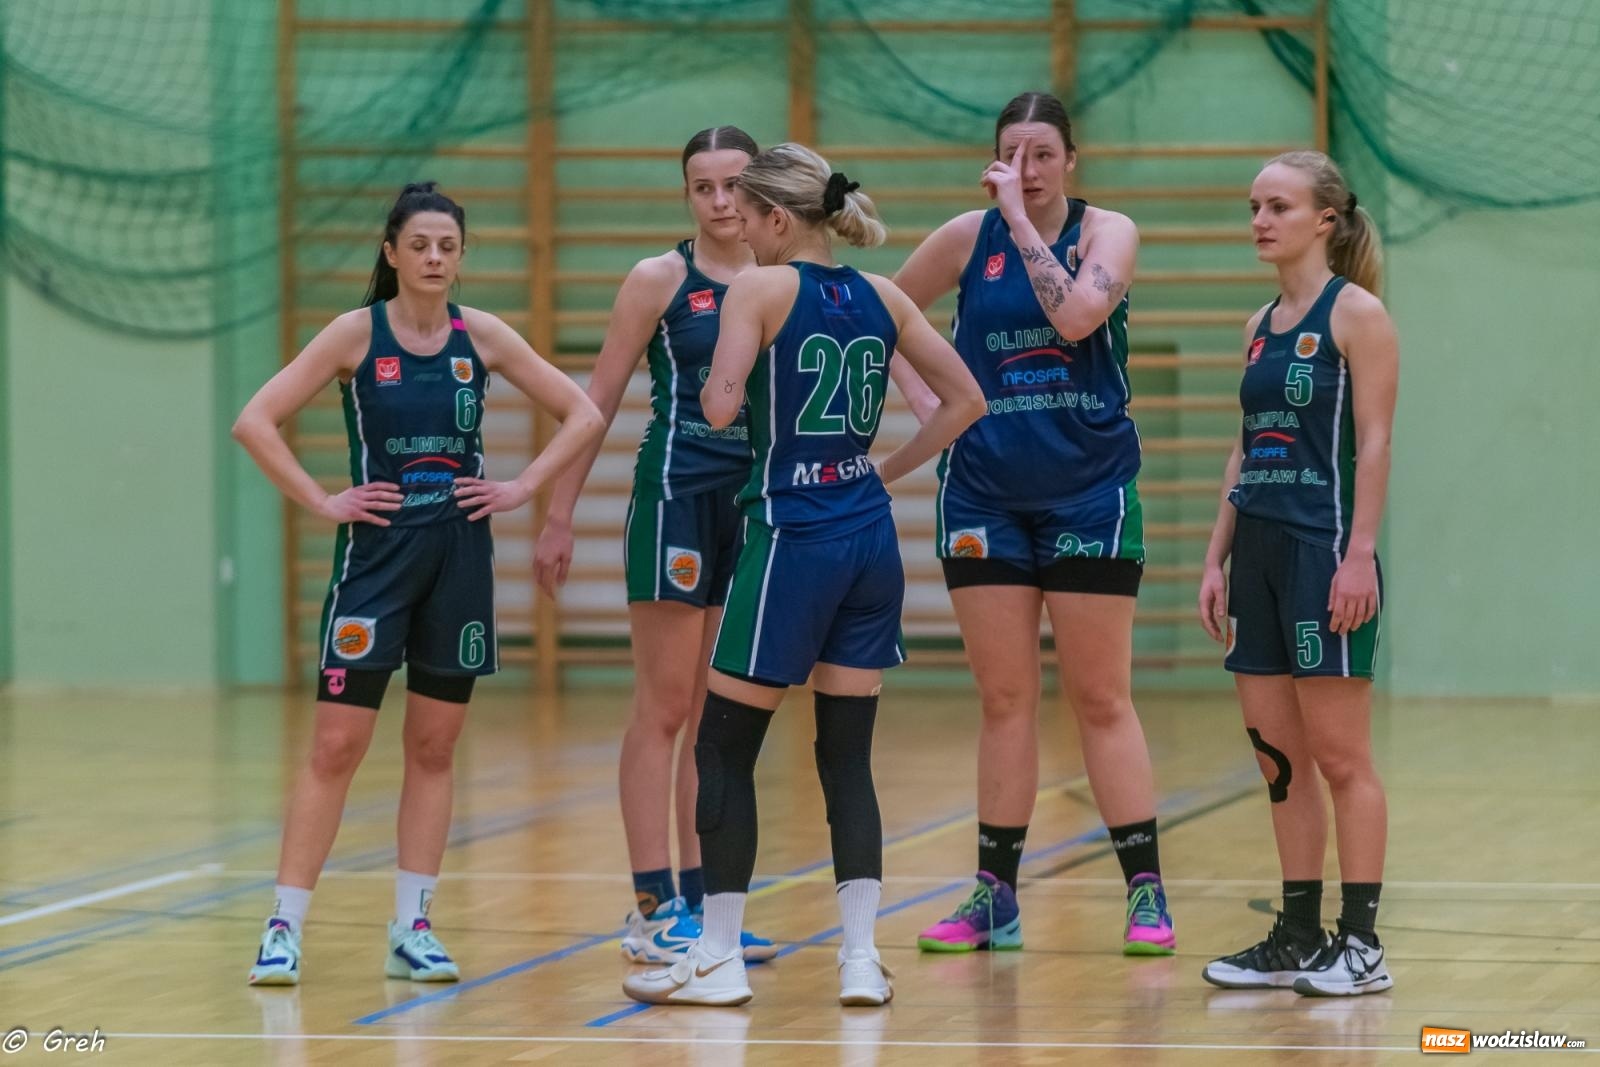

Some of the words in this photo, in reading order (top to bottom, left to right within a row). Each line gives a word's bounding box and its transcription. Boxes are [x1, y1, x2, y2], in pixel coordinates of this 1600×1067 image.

[796, 333, 885, 436] 26
[1002, 367, 1070, 386] INFOSAFE
[1284, 362, 1314, 407] 5
[455, 387, 477, 432] 6
[985, 392, 1078, 415] ODZISŁAW
[386, 436, 466, 455] OLIMPIA
[459, 621, 486, 669] 6
[1296, 621, 1322, 669] 5
